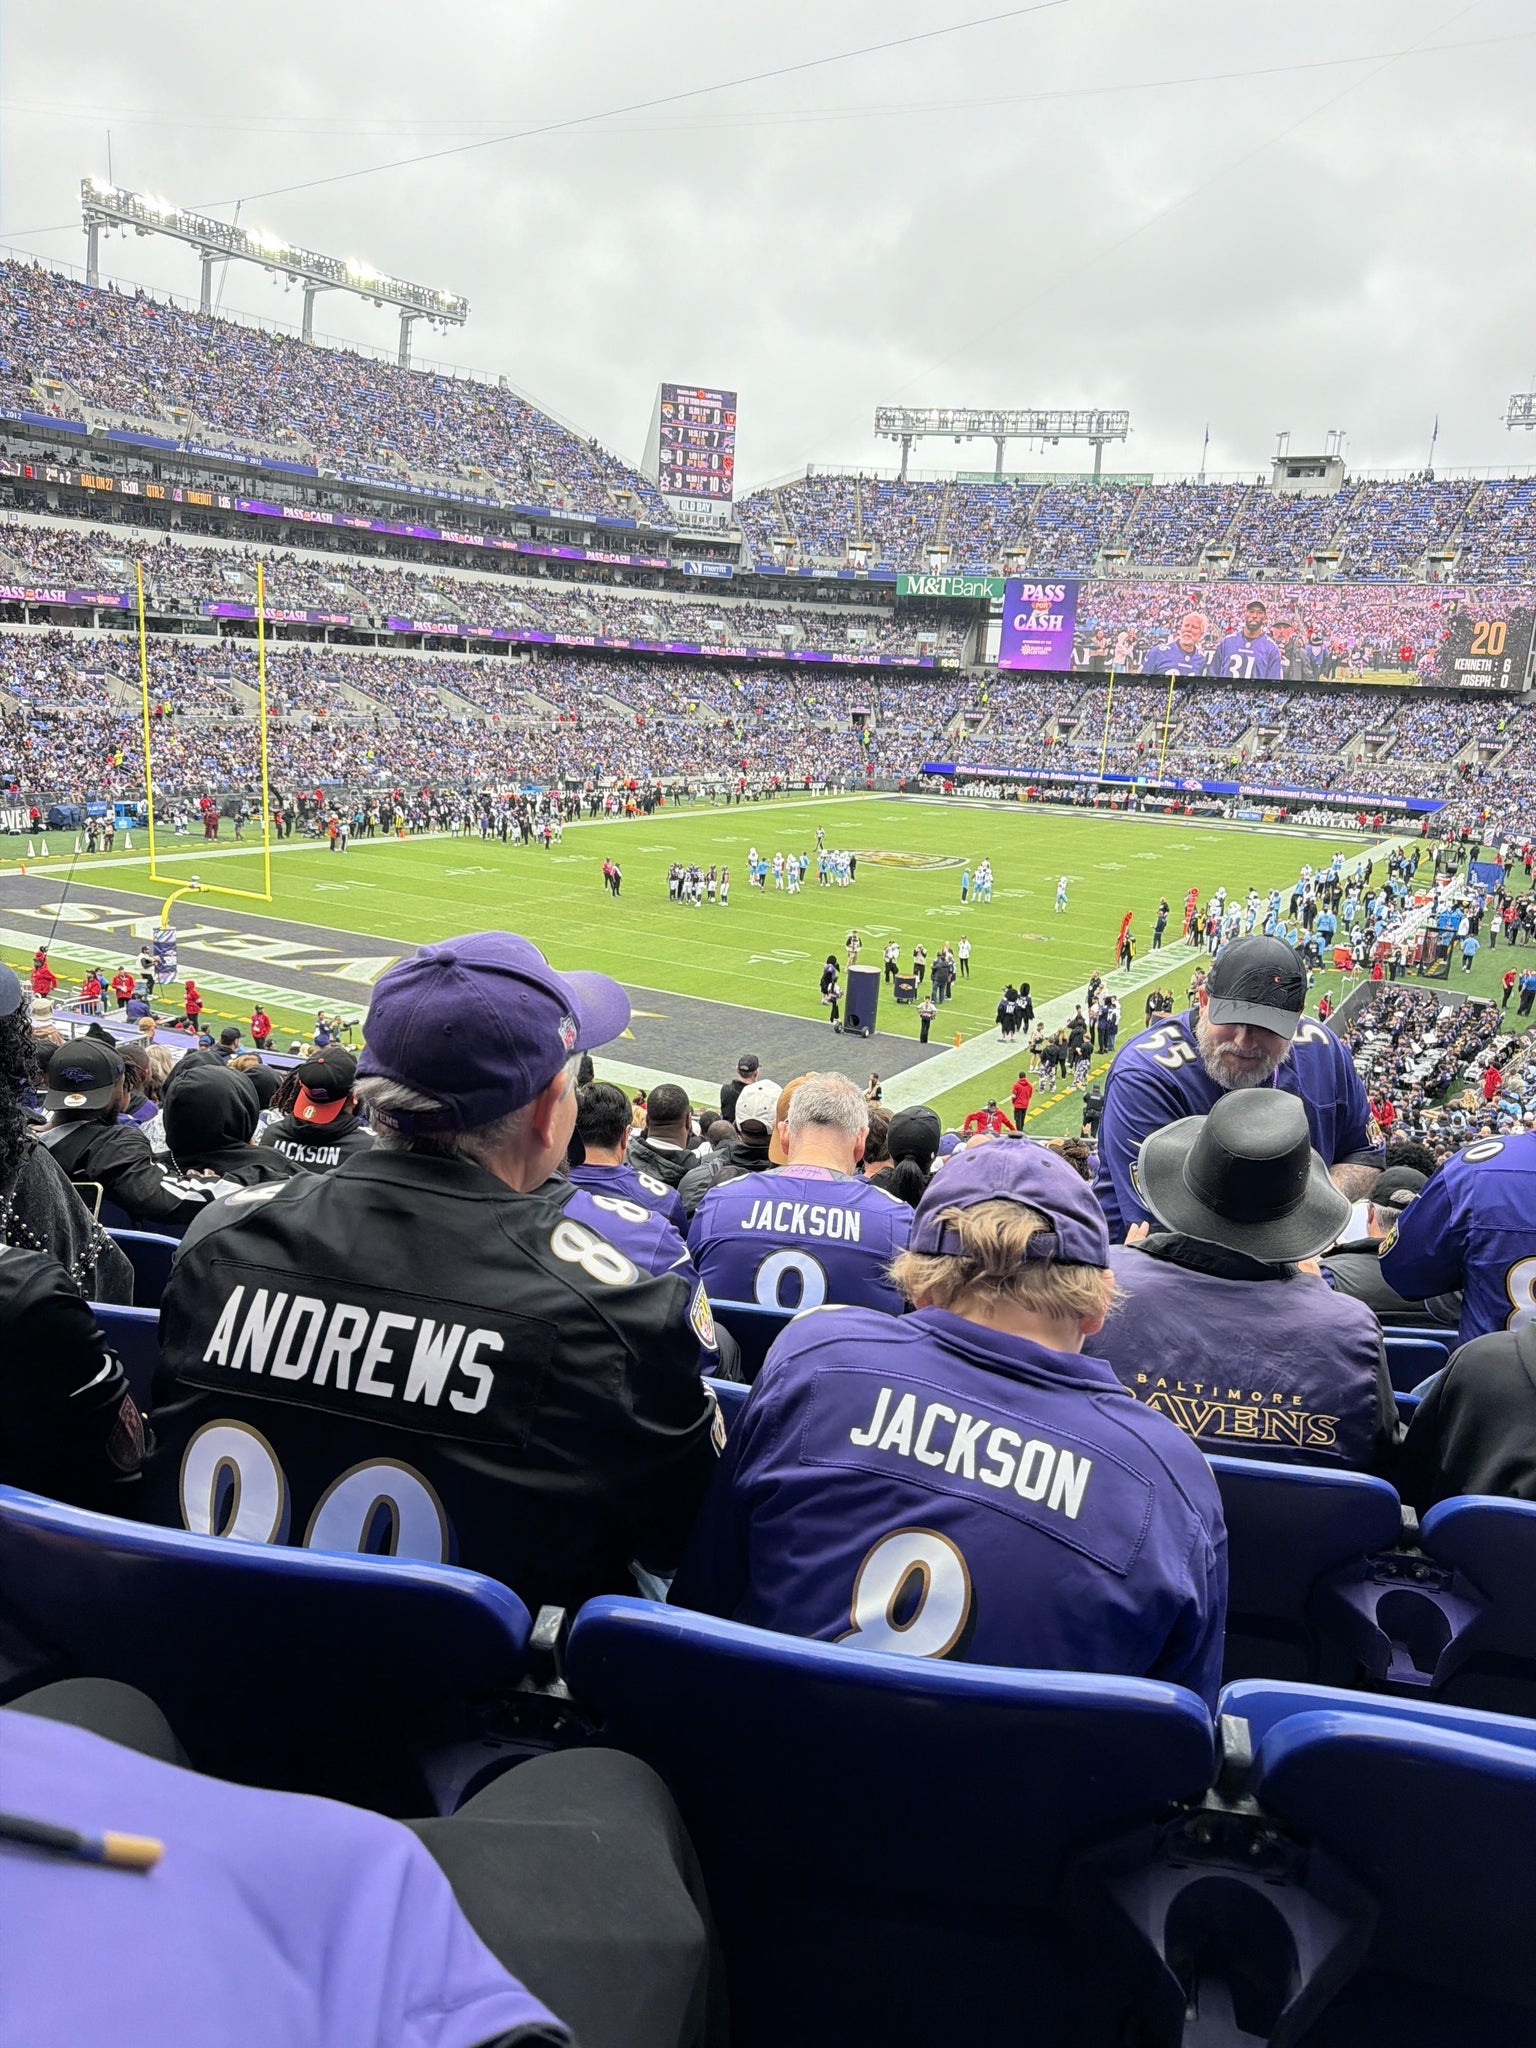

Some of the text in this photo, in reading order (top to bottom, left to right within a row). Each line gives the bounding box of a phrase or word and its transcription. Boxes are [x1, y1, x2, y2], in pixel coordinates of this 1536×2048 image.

[6, 410, 22, 420] 2012
[678, 427, 684, 442] 7
[714, 432, 720, 447] 7
[676, 450, 683, 465] 0
[712, 454, 718, 470] 0
[16, 464, 21, 476] 7
[66, 472, 72, 484] 2
[80, 474, 114, 491] BALL ON 27
[121, 480, 138, 495] 15:00
[710, 476, 719, 492] 10
[146, 484, 160, 498] QTR
[160, 487, 166, 499] 2
[187, 490, 212, 506] TIMEOUT
[218, 496, 230, 509] 1:05
[284, 507, 304, 518] PASS
[310, 511, 333, 524] CASH
[681, 502, 711, 513] OLD BAY
[442, 530, 458, 542] PASS
[465, 534, 484, 546] CASH
[586, 552, 604, 562] PASS
[610, 554, 630, 564] CASH
[702, 565, 727, 574] merritt
[906, 576, 993, 597] M&T Bank
[1020, 584, 1066, 602] PASS
[35, 590, 66, 602] CASH
[284, 610, 307, 622] CASH
[1014, 614, 1064, 632] CASH
[414, 621, 432, 632] PASS
[438, 624, 458, 634] CASH
[556, 634, 571, 644] PASS
[575, 636, 594, 645] CASH
[1470, 622, 1507, 656] 20
[701, 646, 746, 656] PASS CASH
[832, 654, 880, 664] PASS CASH
[1230, 654, 1256, 678] 31
[1454, 658, 1492, 672] KENNETH
[1503, 658, 1512, 672] 6
[1500, 674, 1508, 688] 0
[956, 766, 976, 775] Official
[977, 768, 1008, 777] Investment
[1010, 770, 1031, 778] Partner
[1050, 772, 1078, 781] Baltimore
[1080, 774, 1102, 782] Ravens
[1239, 786, 1407, 808] Official Investment Partner of the Baltimore Ravens
[748, 948, 812, 964] 10
[1136, 1026, 1197, 1070] 55
[274, 1140, 340, 1166] JACKSON
[638, 1170, 669, 1197] 8
[740, 1200, 862, 1242] JACKSON
[550, 1218, 640, 1286] 8
[202, 1284, 504, 1414] ANDREWS
[1137, 1372, 1303, 1406] BALTIMORE
[1122, 1385, 1341, 1446] AVENS
[850, 1387, 1092, 1519] JACKSON
